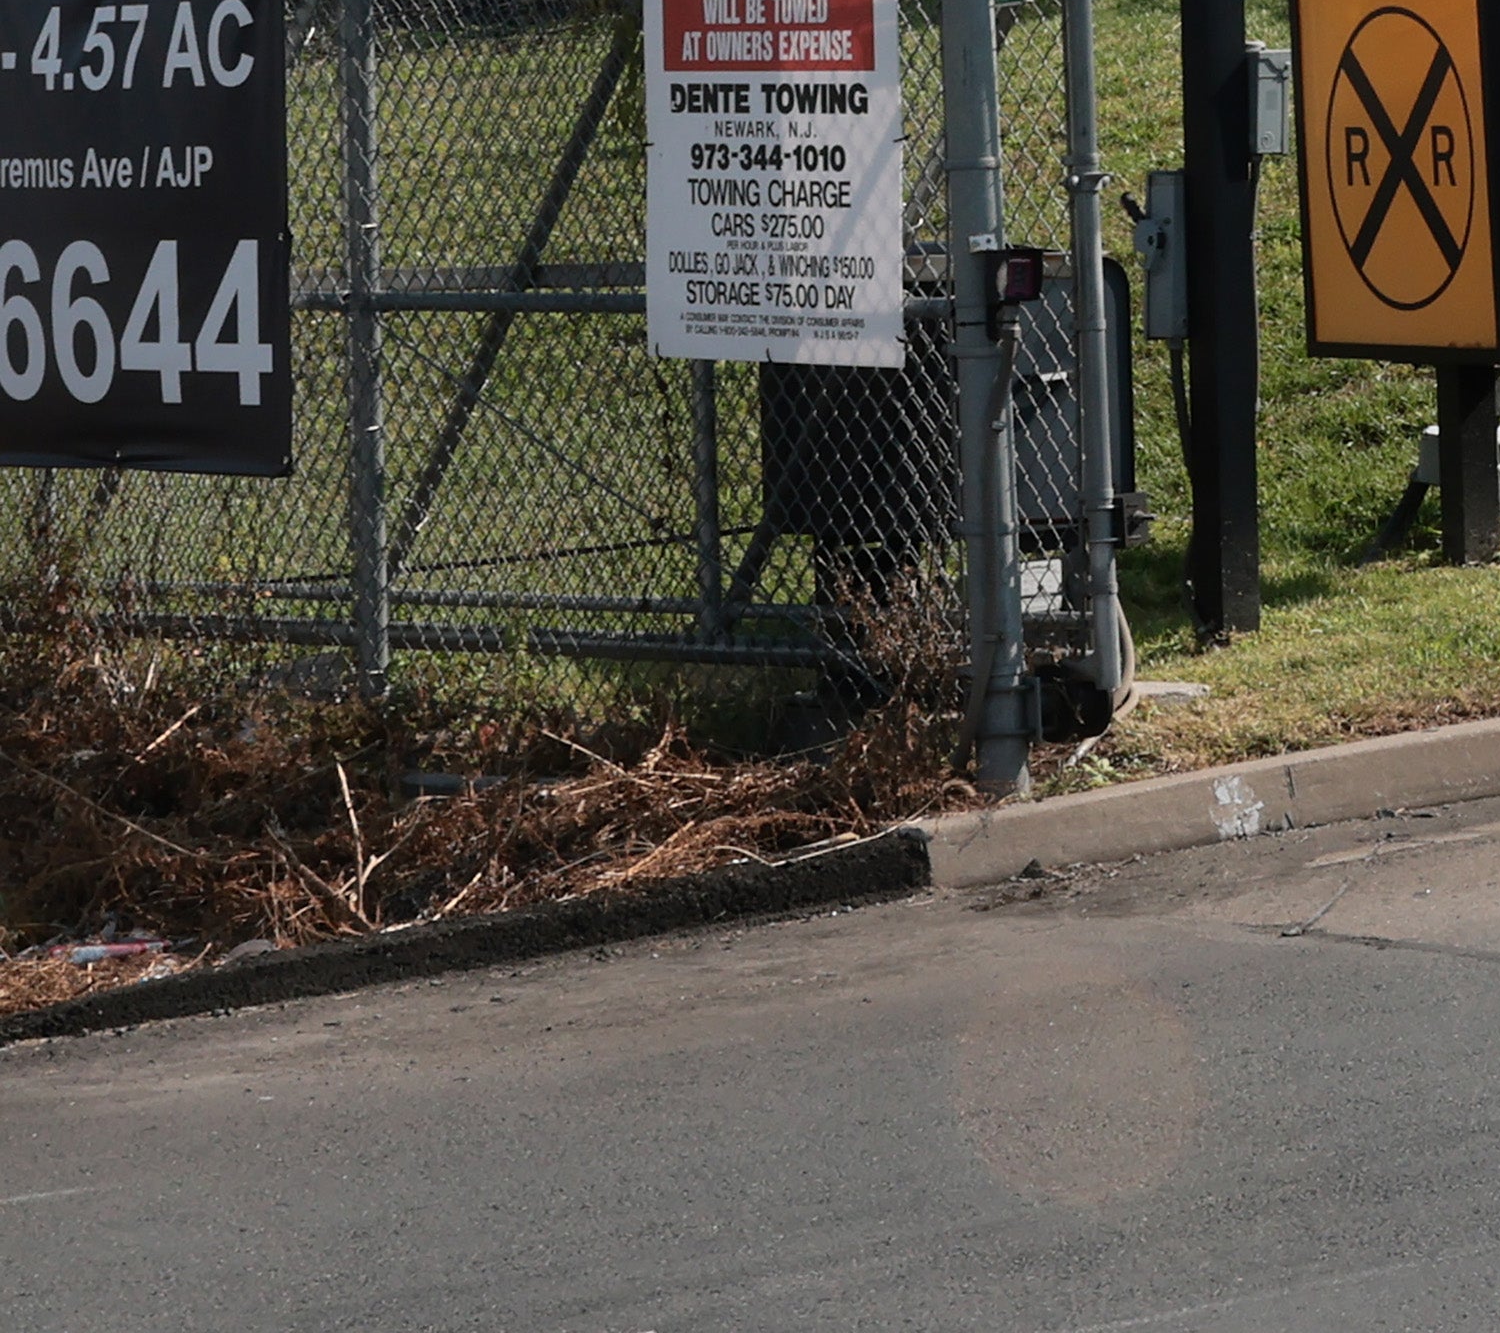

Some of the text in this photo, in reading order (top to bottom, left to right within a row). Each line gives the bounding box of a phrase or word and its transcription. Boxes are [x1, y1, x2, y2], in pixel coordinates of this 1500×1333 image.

[31, 4, 149, 91] 4.57
[682, 30, 852, 62] AT OWNERS EXPENSE
[671, 83, 868, 115] DENTE TOWING
[81, 147, 133, 190] Ave
[156, 145, 213, 189] AJP
[691, 144, 846, 172] 973-344-1010
[688, 178, 851, 208] TOWING CHARGE
[711, 212, 824, 239] CARS $275.00
[726, 240, 739, 249] PER
[741, 240, 758, 250] HOUR
[767, 241, 784, 251] PLUS
[786, 241, 808, 252] LABOR
[715, 252, 730, 276] GO
[769, 254, 775, 277] &
[779, 255, 830, 279] WINCHING
[833, 256, 875, 280] $150.00
[686, 280, 856, 311] STORAGE $75.00 DAY
[807, 316, 840, 328] CONSUMER
